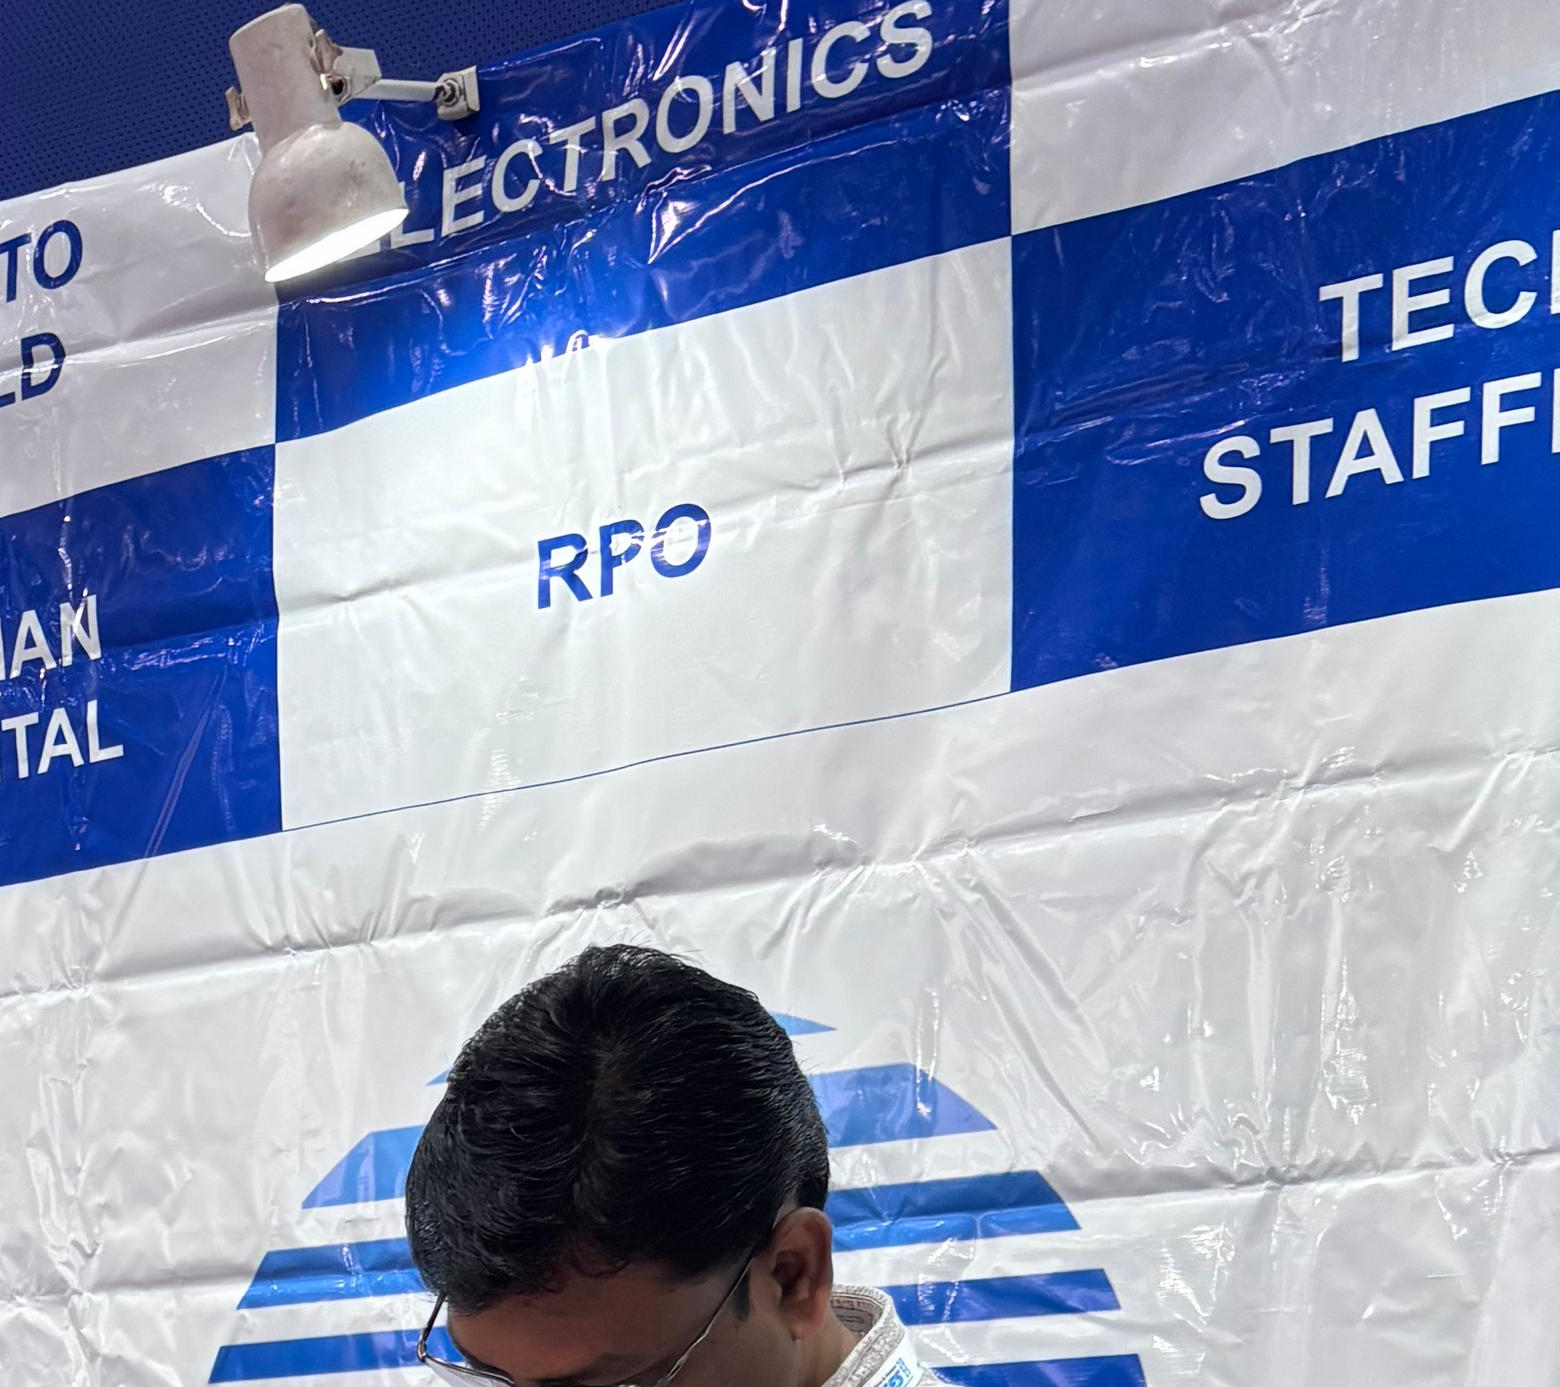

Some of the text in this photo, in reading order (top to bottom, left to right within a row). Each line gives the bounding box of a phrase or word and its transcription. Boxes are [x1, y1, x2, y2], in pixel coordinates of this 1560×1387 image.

[340, 2, 934, 262] LECTRONICS
[1319, 229, 1560, 363] TEC
[536, 503, 712, 611] RPO
